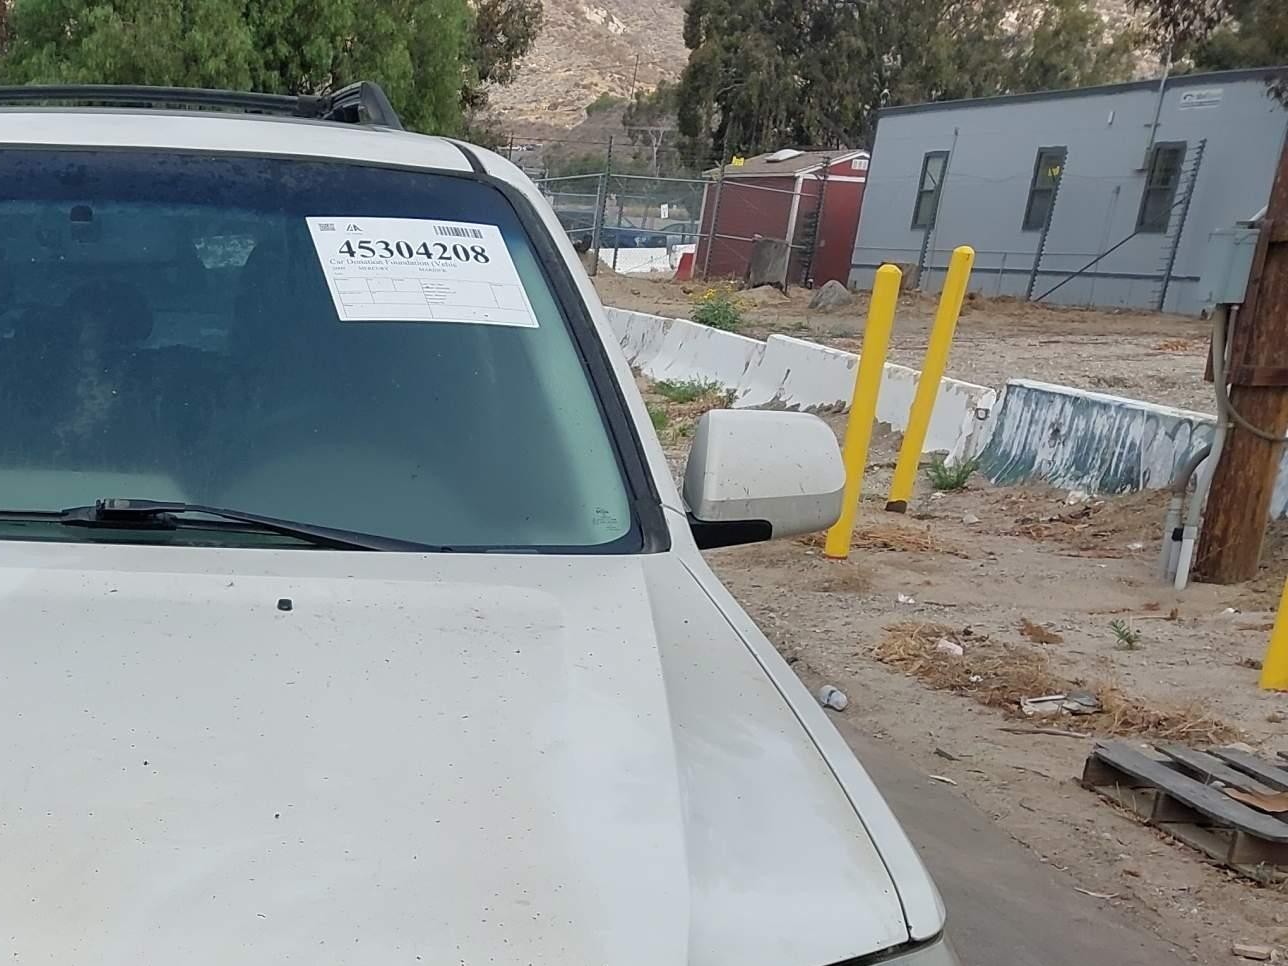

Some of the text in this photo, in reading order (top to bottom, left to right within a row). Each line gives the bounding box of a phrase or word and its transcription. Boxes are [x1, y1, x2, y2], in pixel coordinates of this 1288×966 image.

[338, 239, 490, 264] 45304208
[346, 258, 384, 266] Donation
[385, 259, 430, 267] Foundation
